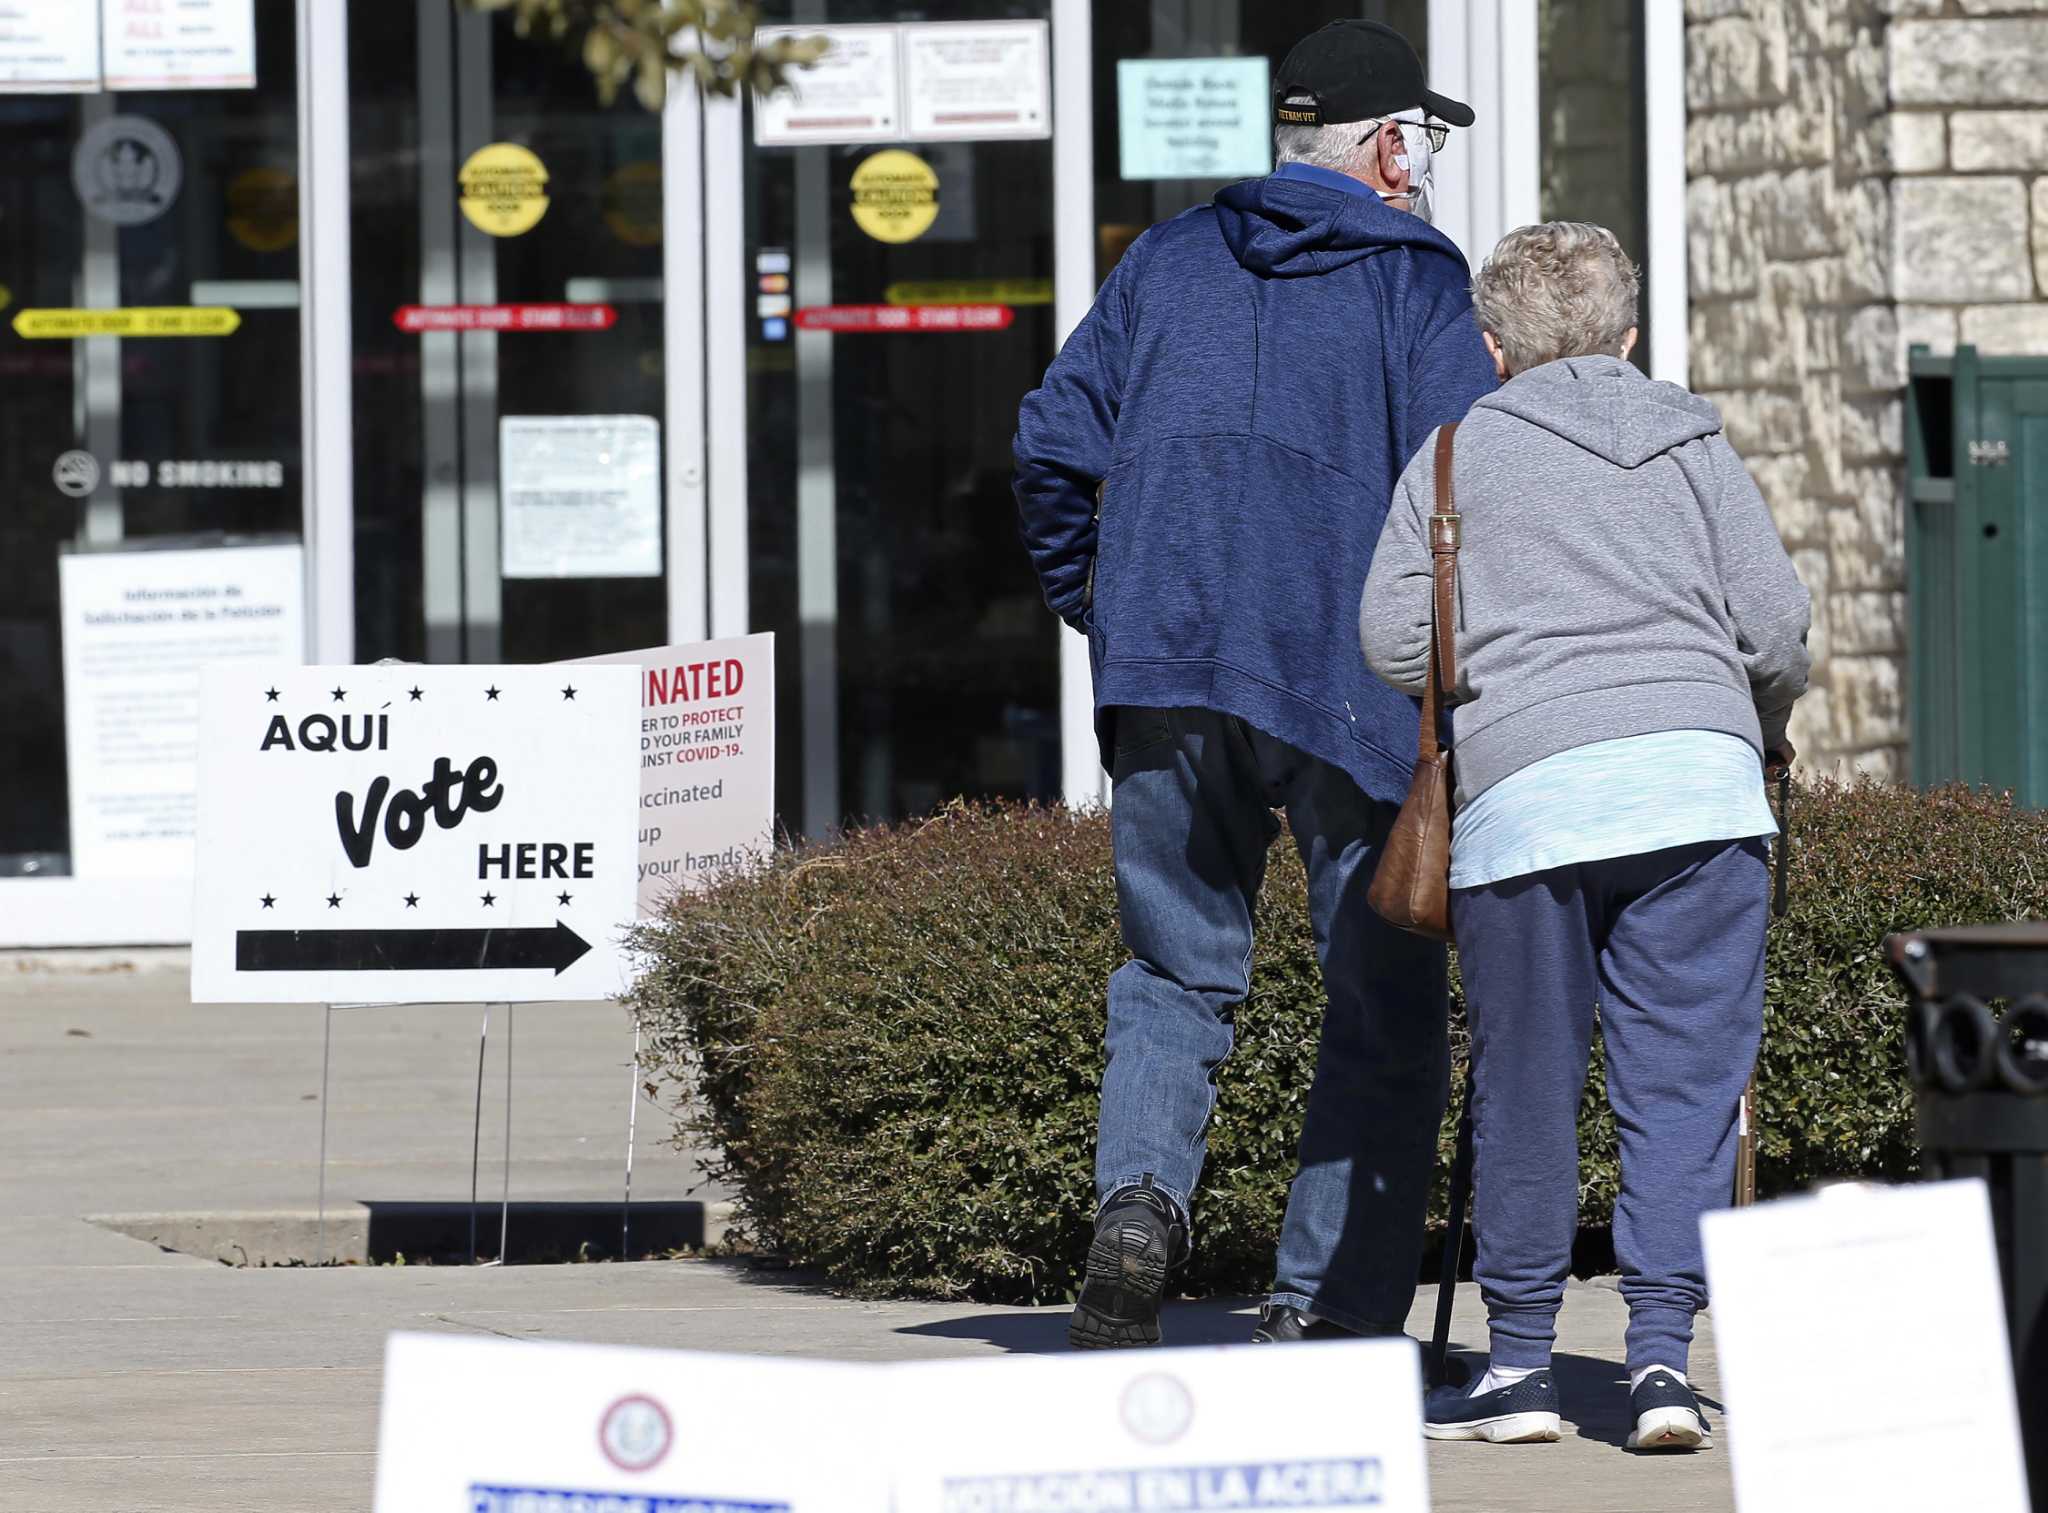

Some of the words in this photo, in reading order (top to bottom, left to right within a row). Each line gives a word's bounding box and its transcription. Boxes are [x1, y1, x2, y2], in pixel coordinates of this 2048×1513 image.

[109, 460, 149, 488] NO
[158, 460, 283, 488] SMOKING
[259, 701, 392, 753] AQUÍ
[660, 715, 680, 730] TO
[682, 706, 744, 727] PROTECT
[653, 731, 692, 749] YOUR
[694, 724, 744, 743] FAMILY
[641, 751, 674, 768] INST
[676, 743, 744, 763] COVID-19.
[334, 755, 505, 869] Vote
[477, 841, 595, 880] HERE
[637, 857, 681, 882] your
[685, 846, 742, 871] hands
[1137, 1471, 1191, 1510] EN
[1201, 1468, 1251, 1507] LA
[1254, 1461, 1380, 1504] ACERA
